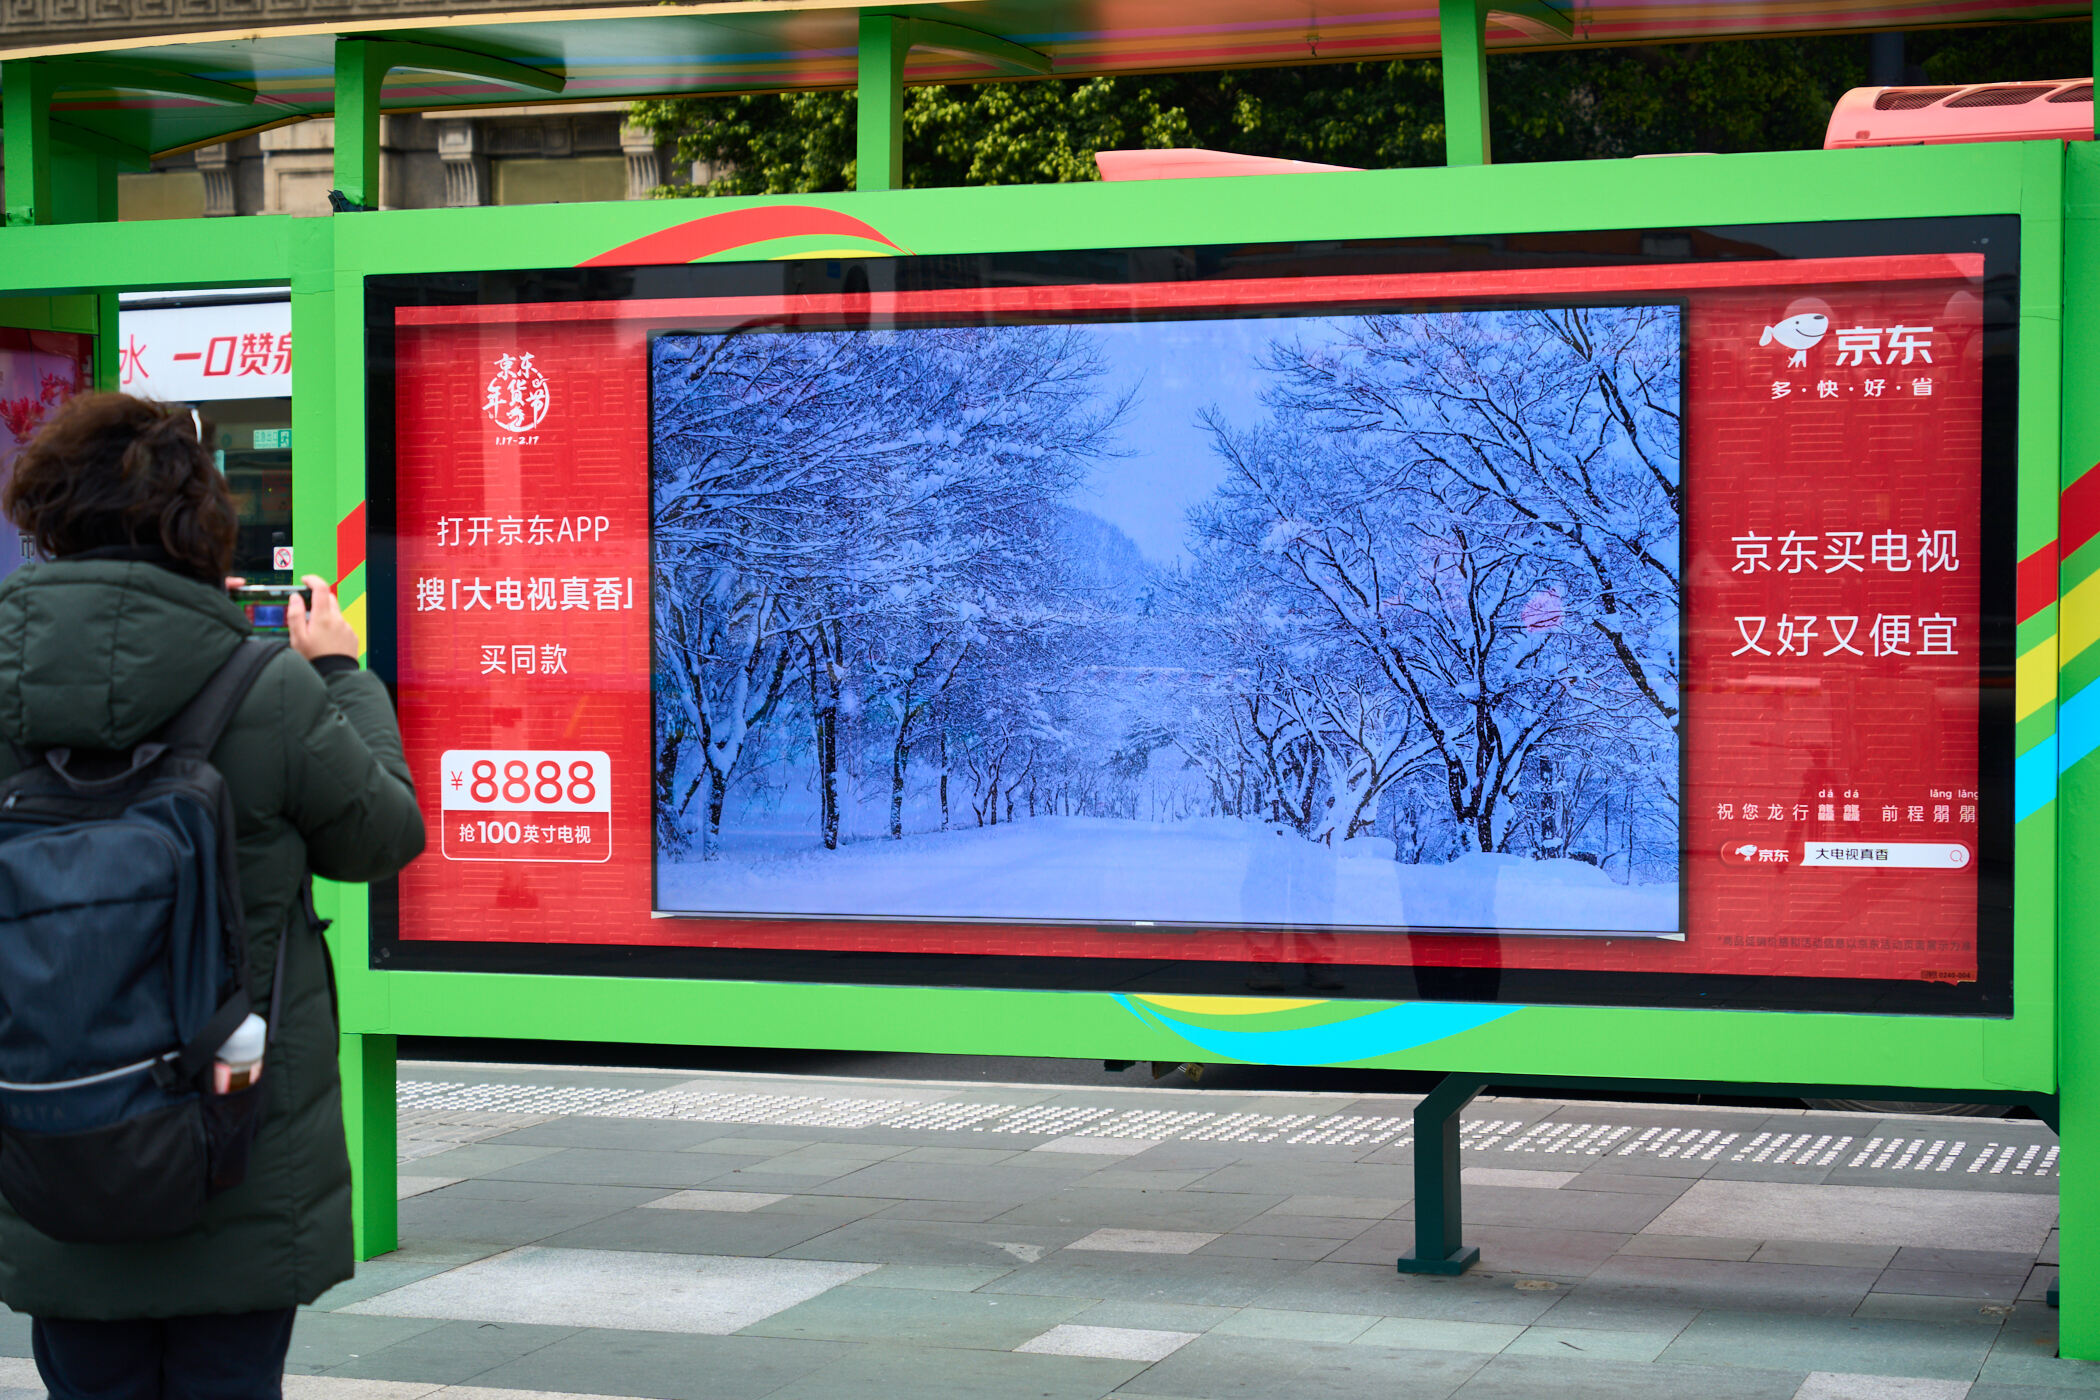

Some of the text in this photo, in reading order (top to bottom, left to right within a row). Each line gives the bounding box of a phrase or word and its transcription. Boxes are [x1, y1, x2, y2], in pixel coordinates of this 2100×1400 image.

[1835, 324, 1934, 367] 京东
[493, 352, 544, 381] 京东
[495, 435, 540, 446] 1.17-2.17
[436, 514, 610, 547] 打开京东APP
[1731, 528, 1960, 574] 京东买电视
[1731, 612, 1959, 657] 又好又便宜
[480, 643, 568, 675] 买同款
[459, 820, 592, 844] 抢100英寸电视
[1758, 848, 1889, 863] 京东 大电视真香
